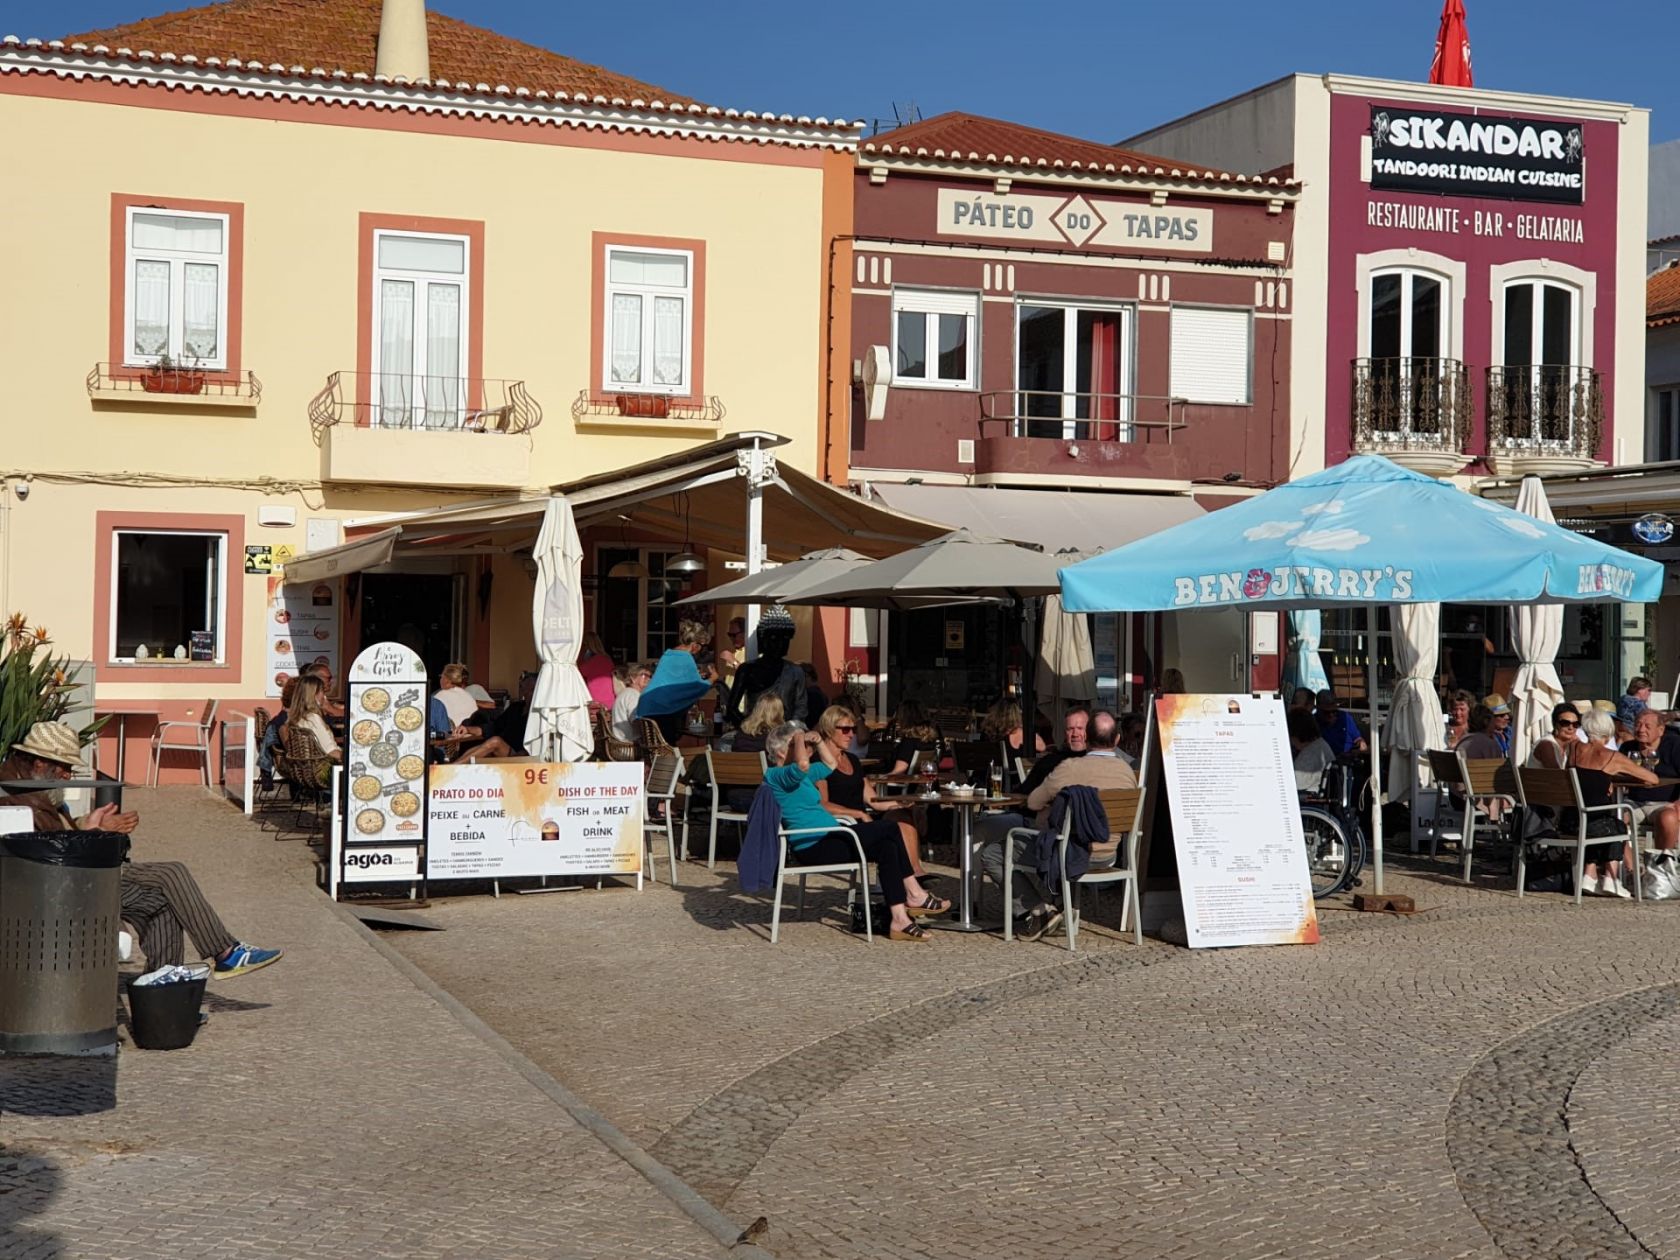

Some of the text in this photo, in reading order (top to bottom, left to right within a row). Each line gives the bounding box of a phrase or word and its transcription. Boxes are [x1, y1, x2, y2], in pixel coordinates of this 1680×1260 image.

[1388, 116, 1566, 160] SIKANDAR
[1373, 158, 1582, 189] TANDOORI INDIAN CUISINE
[953, 196, 1198, 241] PÁTEO DO TAPAS
[1367, 201, 1585, 244] RESTAURANTE BAR GELATARIA
[524, 768, 549, 785] 9€
[432, 787, 505, 799] PRATO DO DIA
[558, 786, 639, 797] DISH OF THE DAY
[430, 810, 459, 820] PEIXE
[473, 809, 506, 819] CARNE
[566, 807, 589, 816] FISH
[603, 806, 630, 815] MEAT
[1418, 816, 1454, 828] Laoa
[450, 831, 486, 841] BEBIDA
[583, 827, 613, 837] DRINK
[344, 852, 393, 869] agoa
